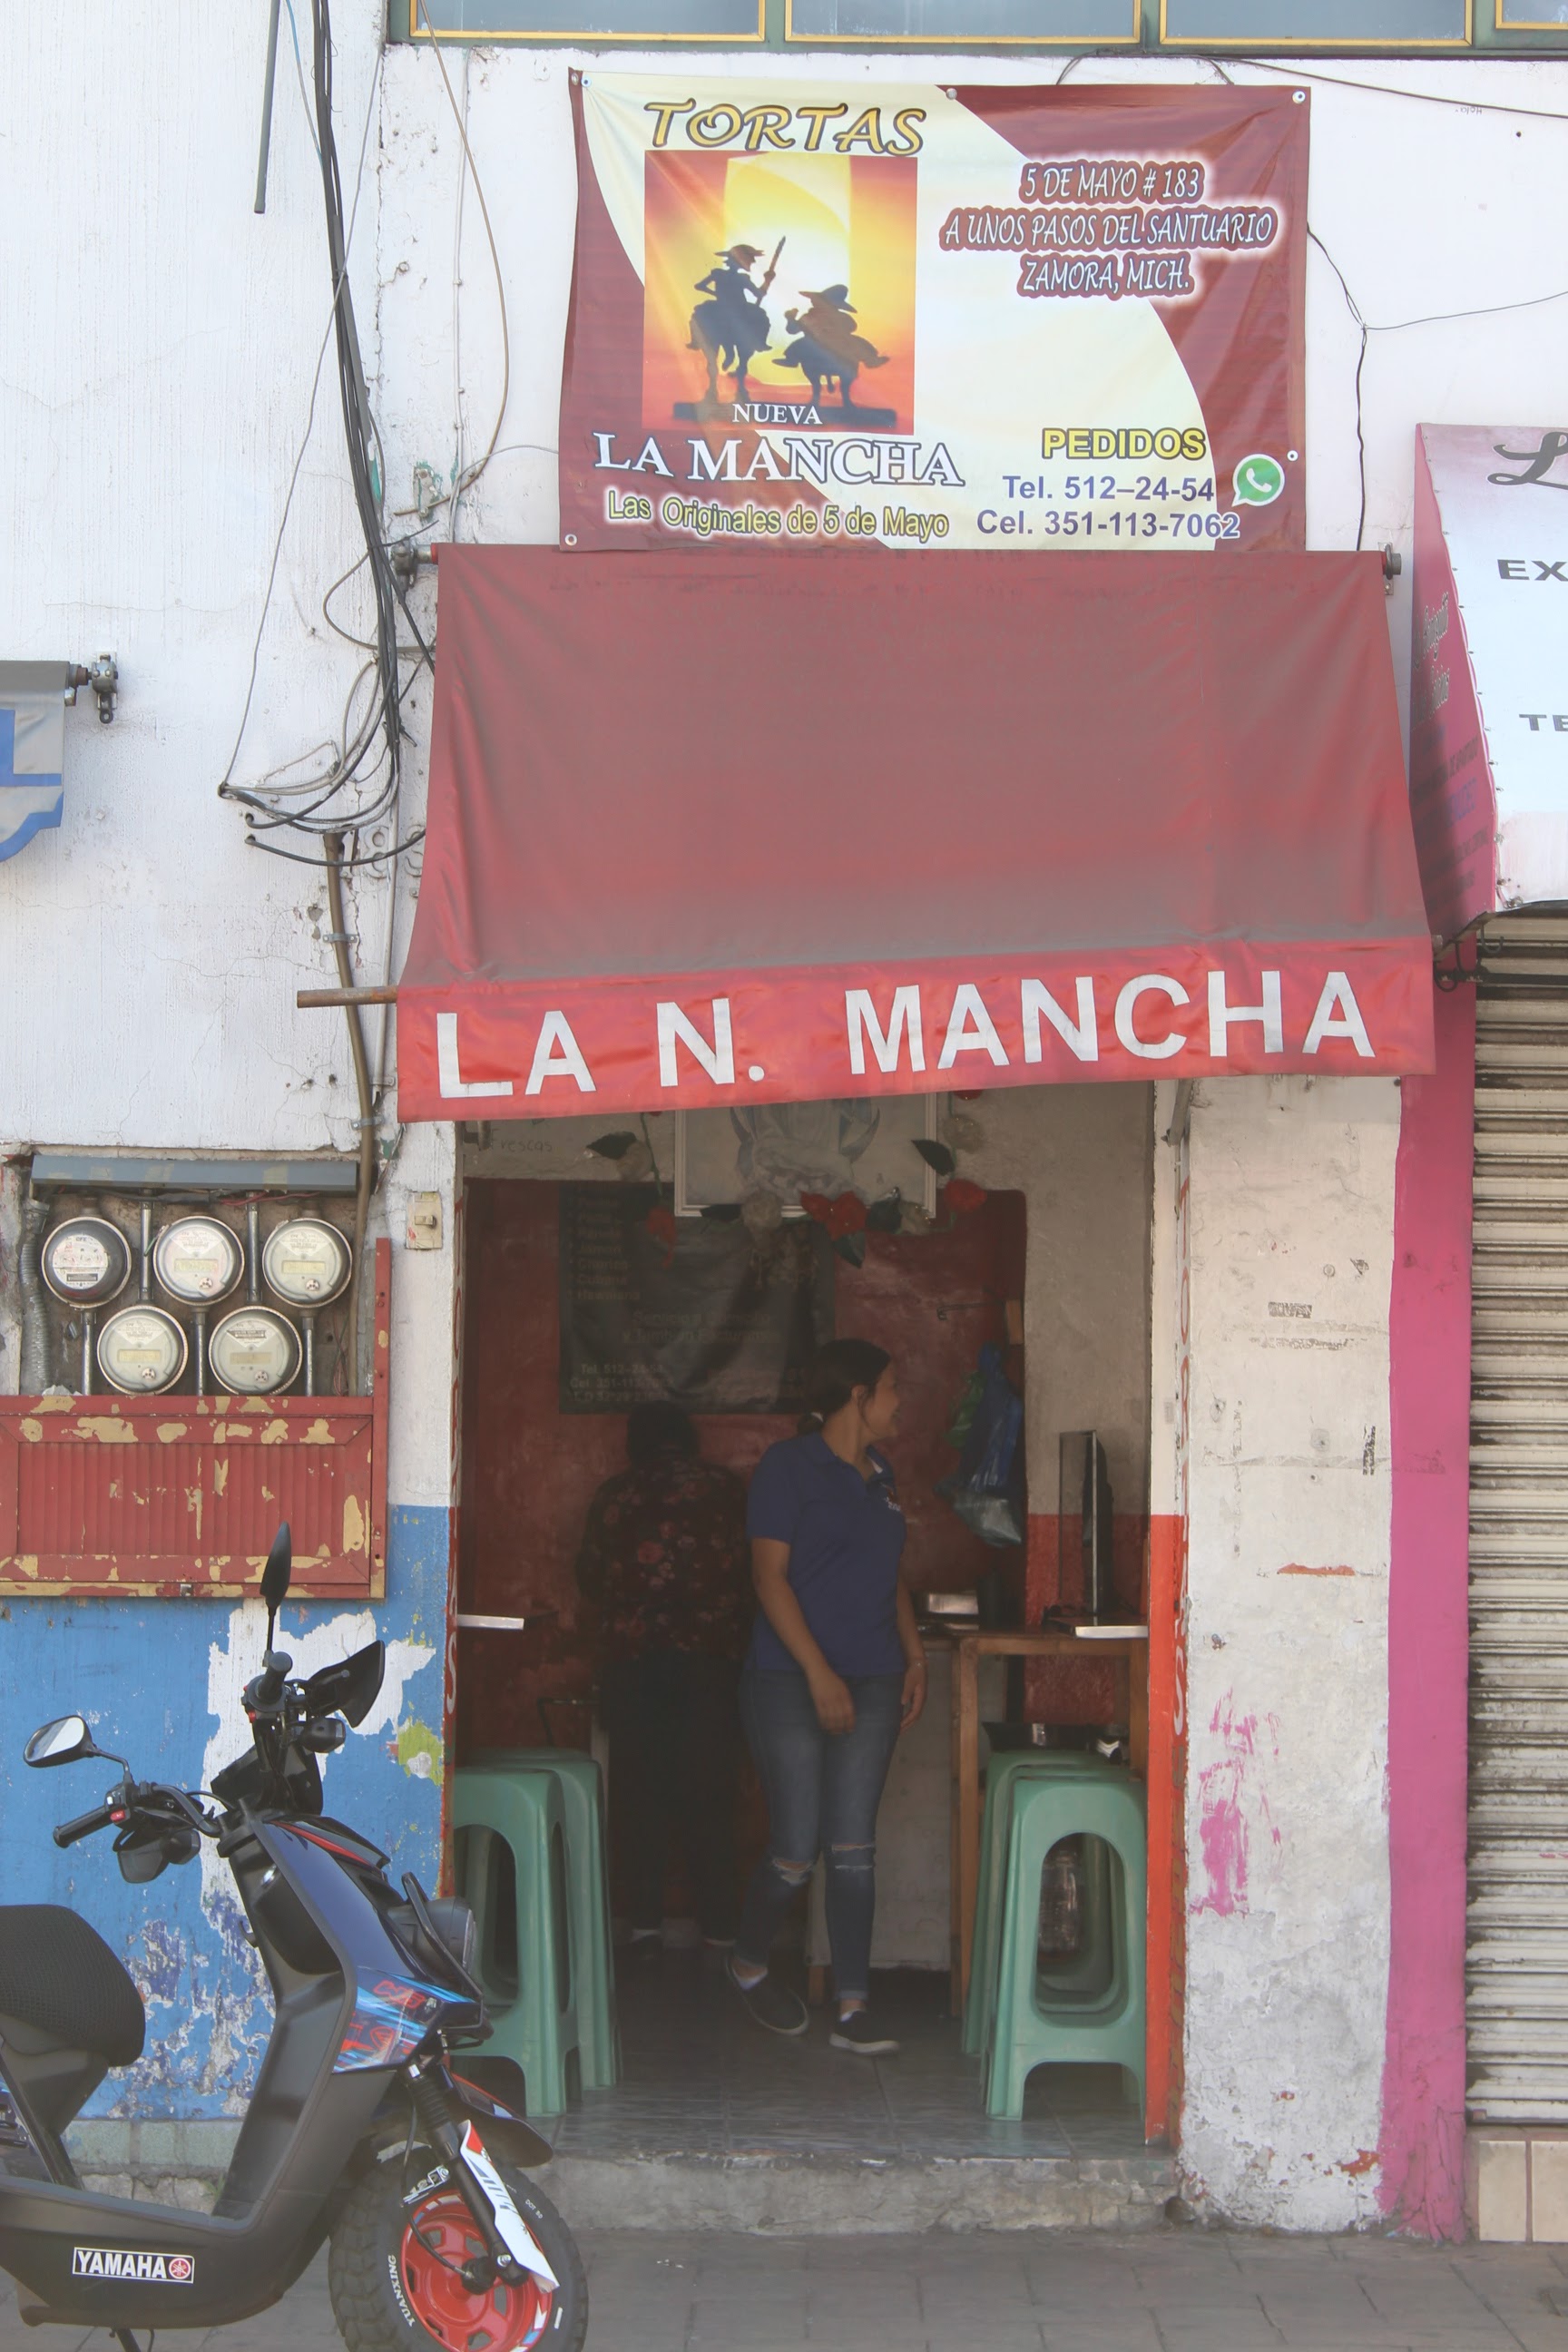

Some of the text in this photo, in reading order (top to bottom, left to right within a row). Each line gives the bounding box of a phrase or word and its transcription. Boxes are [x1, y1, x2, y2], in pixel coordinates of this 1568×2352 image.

[643, 98, 927, 157] TORTAS
[1024, 167, 1200, 198] 5 DE MAYO # 183
[946, 211, 1273, 245] A UNOS PASOS DEL SANTUARIO
[1022, 258, 1191, 295] ZAMORA, MICH.
[731, 403, 823, 426] NUEVA
[593, 431, 967, 486] LA MANCHA
[1042, 427, 1207, 461] PEDIDOS
[1003, 475, 1215, 502] Tel. 512-24-54
[608, 490, 950, 543] Las Originales de 5 de Mayo
[977, 510, 1241, 540] Cel. 351-113-7062
[436, 970, 1377, 1098] LA N. MANCHA
[78, 2250, 168, 2278] YAMAHA
[387, 2254, 416, 2327] YUANXING
